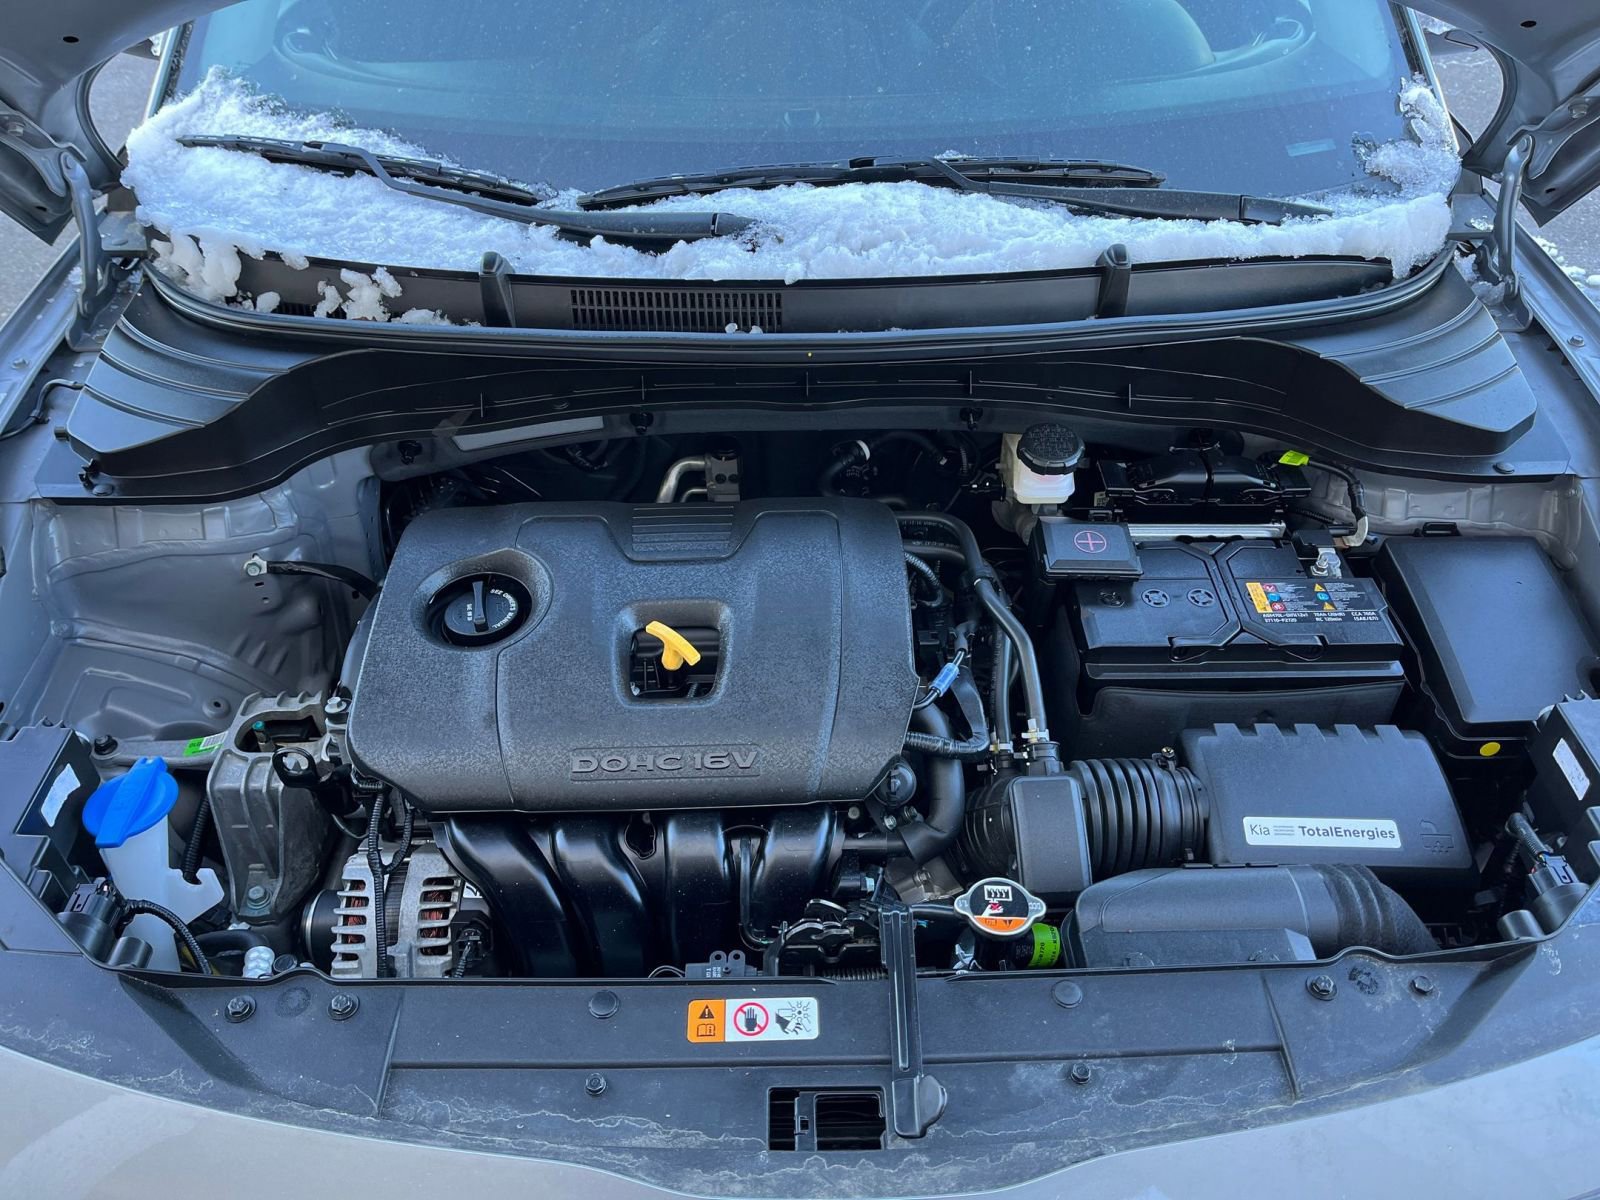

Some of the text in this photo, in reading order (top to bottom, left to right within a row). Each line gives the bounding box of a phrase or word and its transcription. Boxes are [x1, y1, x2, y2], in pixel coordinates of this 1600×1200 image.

[572, 751, 758, 773] DOHC 16V
[1250, 824, 1396, 840] Kia TotalEnergies
